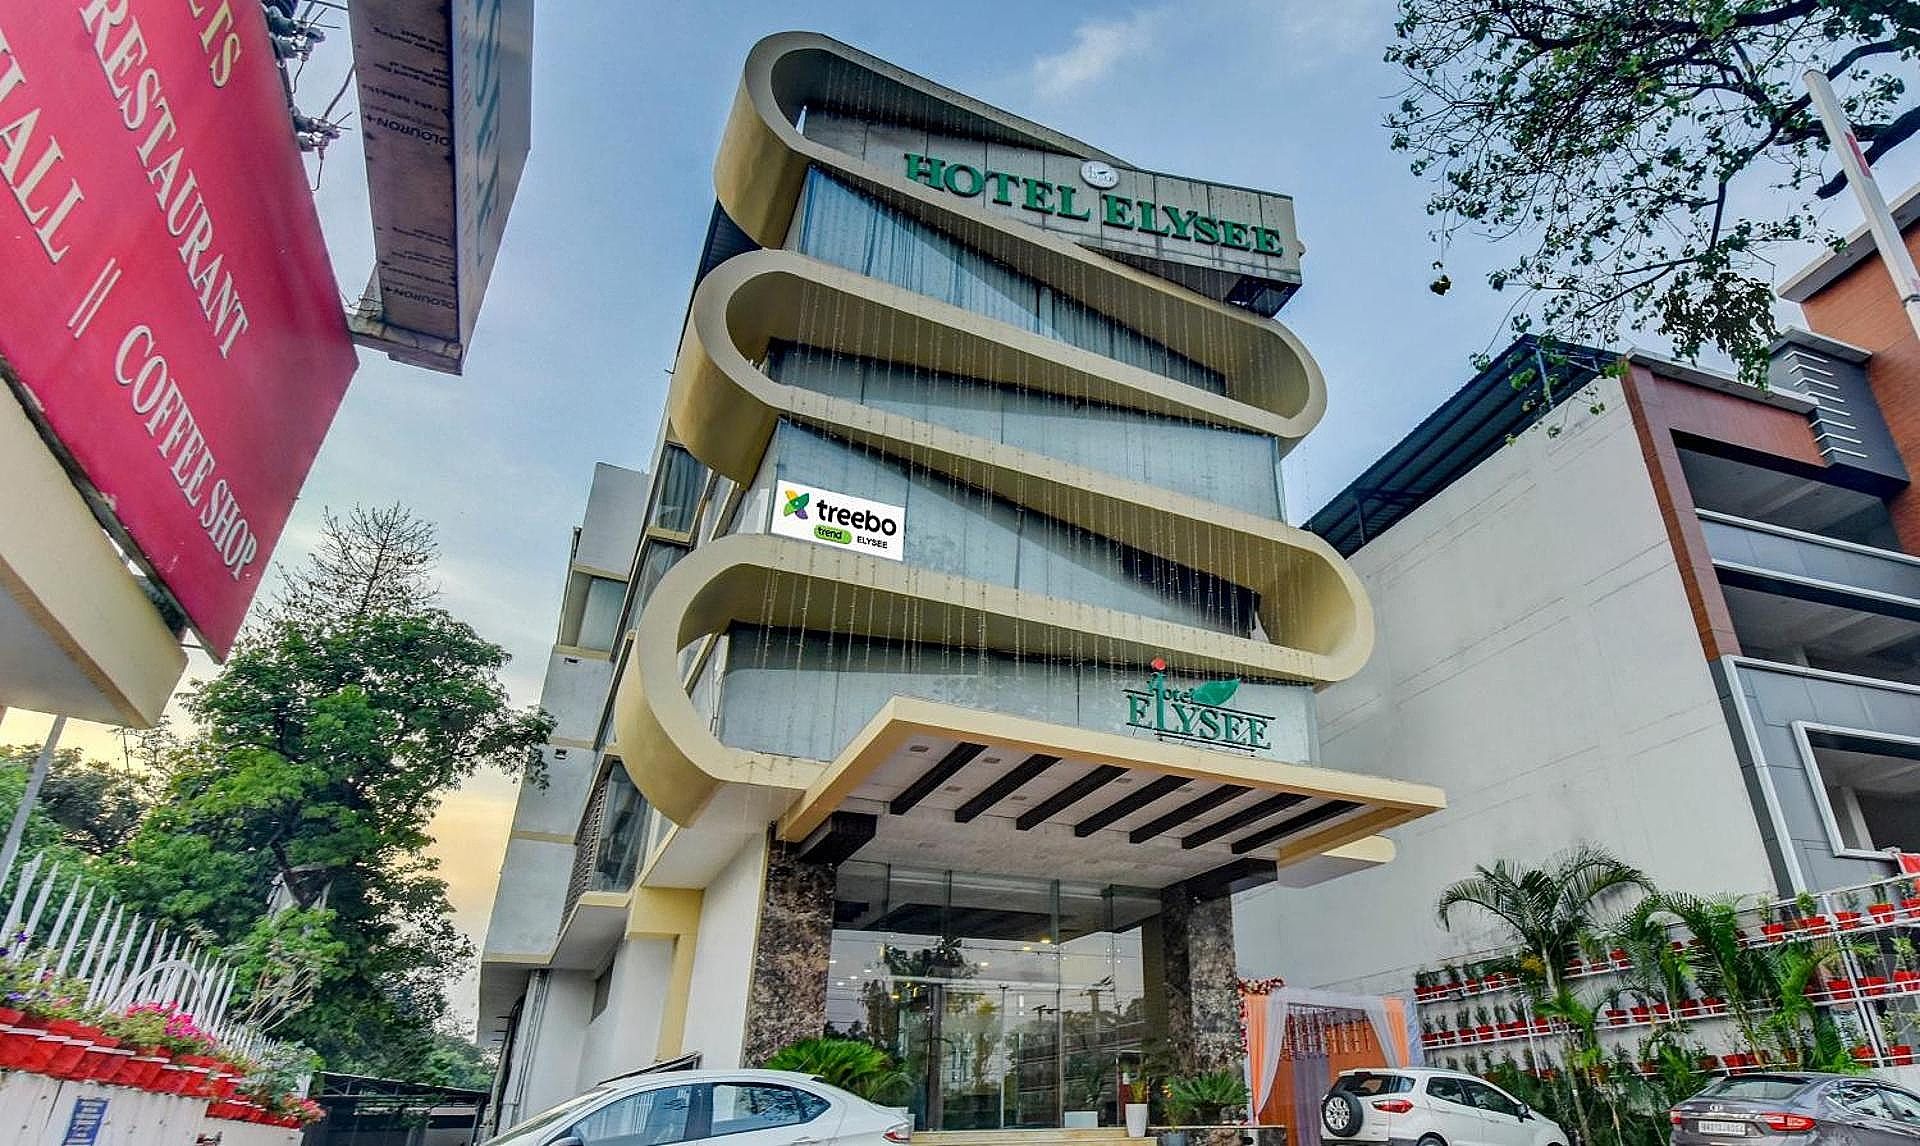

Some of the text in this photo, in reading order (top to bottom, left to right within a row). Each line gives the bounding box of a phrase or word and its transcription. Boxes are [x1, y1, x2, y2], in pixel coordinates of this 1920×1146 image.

[79, 0, 249, 359] RESTAURANT
[904, 152, 1284, 257] HOTEL ELYSEE
[115, 325, 257, 580] COFFEE SHOP
[816, 500, 897, 536] treebo
[818, 526, 888, 550] trend ELYSEE
